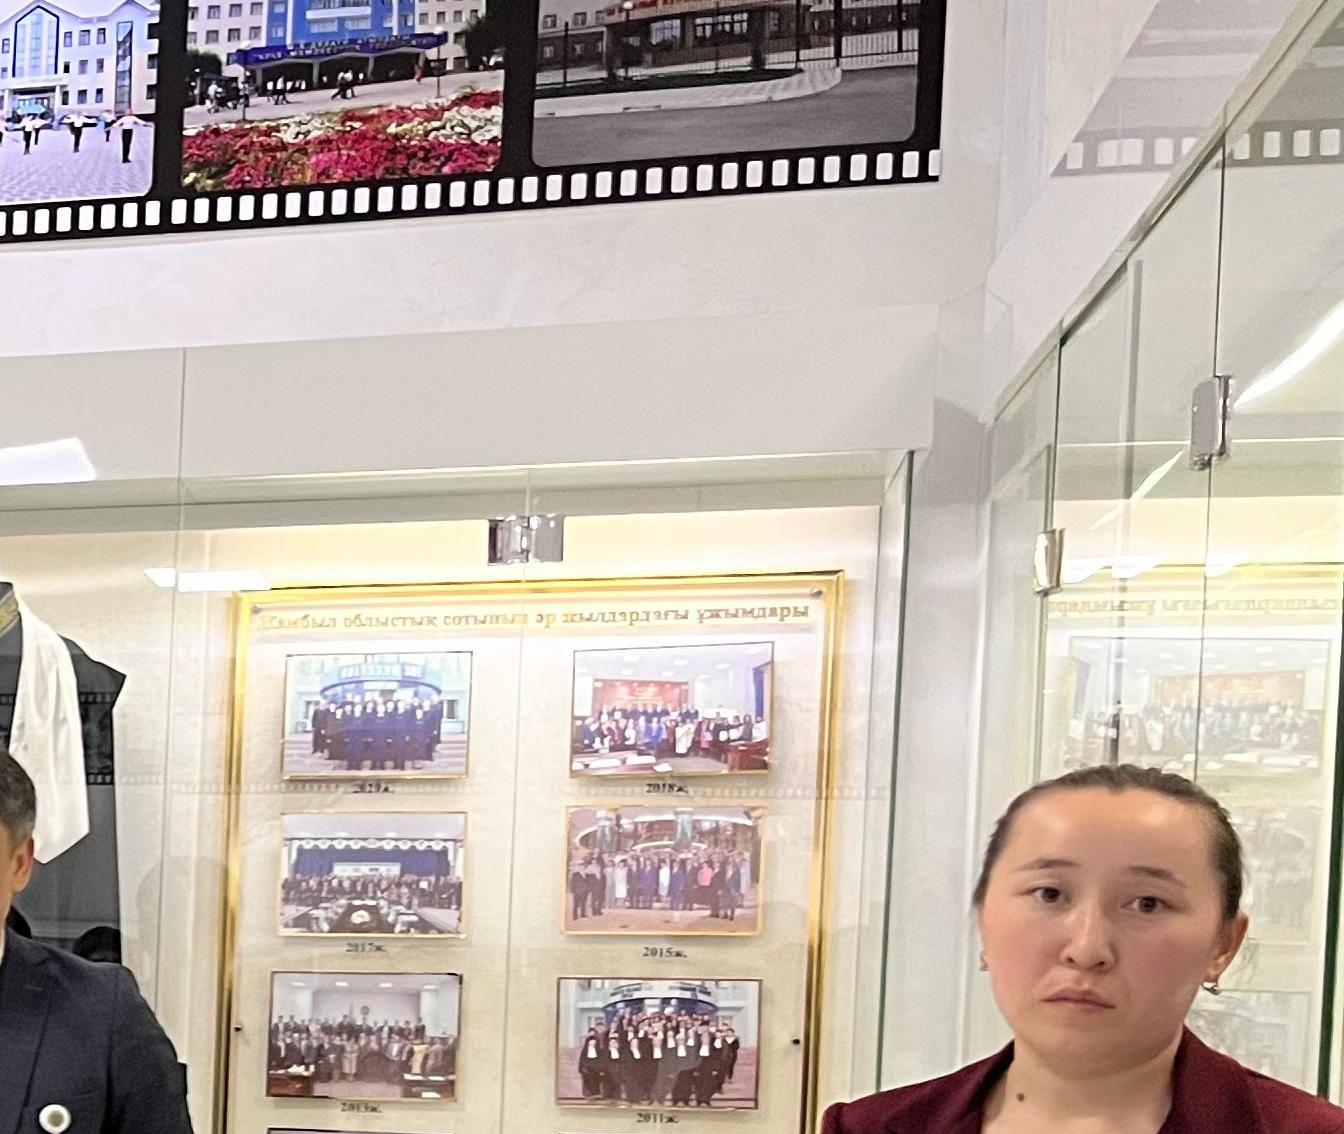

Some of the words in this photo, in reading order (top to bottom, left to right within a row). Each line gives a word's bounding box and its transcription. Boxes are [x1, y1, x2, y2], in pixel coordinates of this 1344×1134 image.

[343, 613, 438, 630] облыстық
[443, 612, 529, 629] сотының
[536, 611, 557, 630] әр
[563, 607, 690, 627] жылдардағы
[696, 604, 810, 625] ұжымдары
